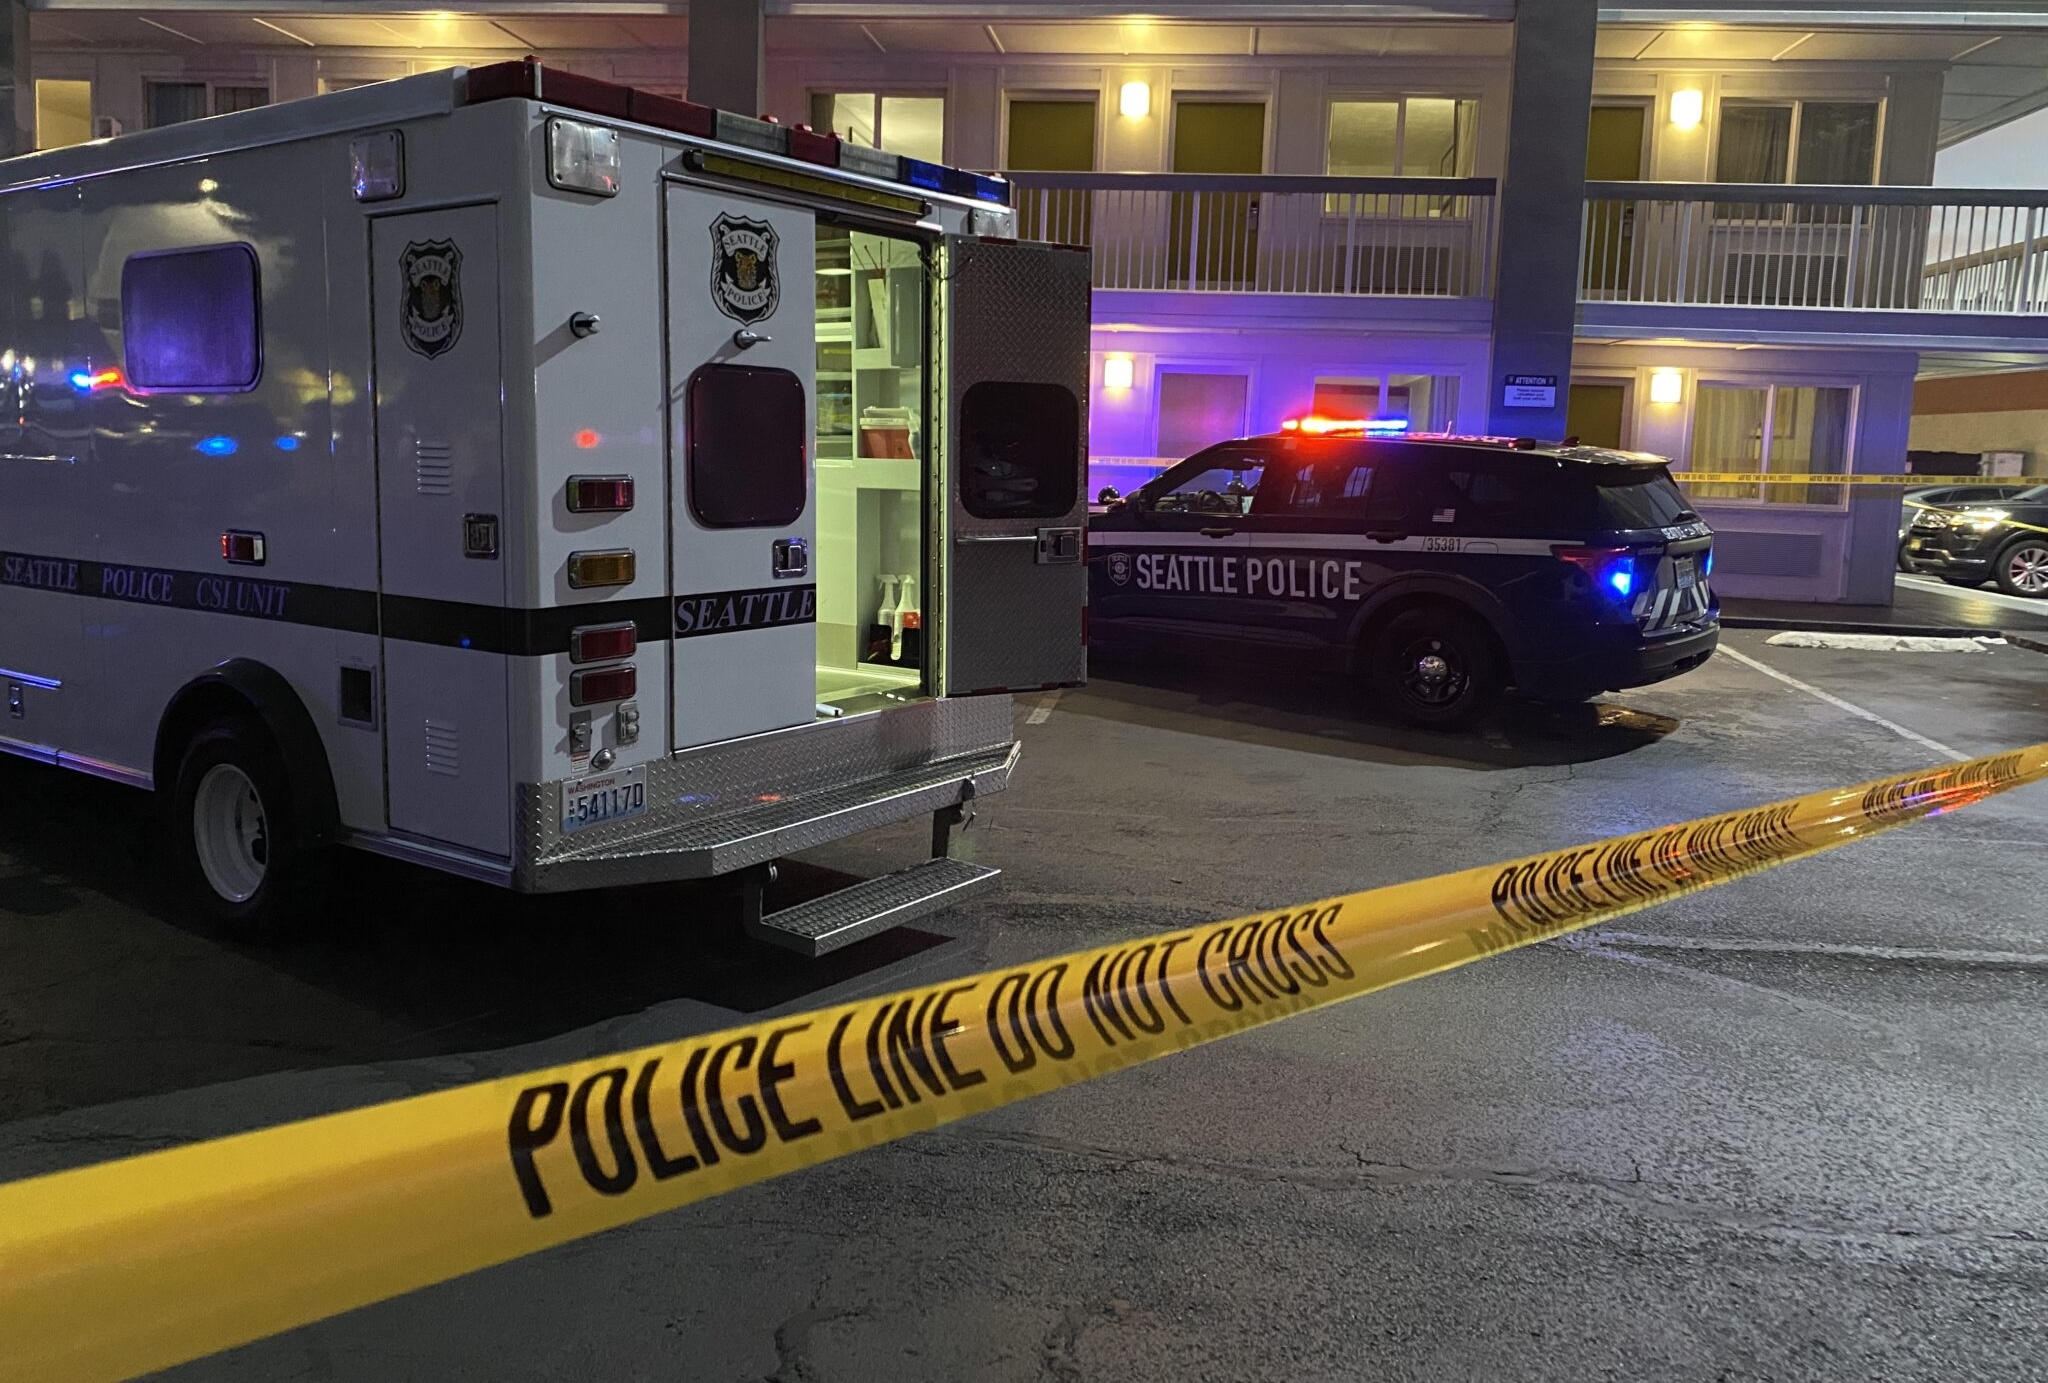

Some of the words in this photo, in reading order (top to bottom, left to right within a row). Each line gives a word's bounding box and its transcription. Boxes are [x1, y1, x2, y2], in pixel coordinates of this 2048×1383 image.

[723, 234, 768, 253] SEATTLE
[727, 289, 765, 306] POLICE
[413, 317, 450, 338] POLICE
[1427, 537, 1461, 552] 35381
[3, 556, 78, 591] SEATTLE
[101, 566, 174, 602] POLICE
[197, 577, 230, 610] CSI
[236, 583, 290, 616] UNIT
[1136, 553, 1238, 594] SEATTLE
[1246, 556, 1362, 600] POLICE
[675, 588, 816, 633] SEATTLE
[567, 778, 616, 795] WASHINGTON
[1491, 847, 1610, 932] POLICE
[1592, 835, 1668, 901] LINE
[508, 1021, 823, 1219] POLICE
[827, 982, 987, 1122] LINE
[986, 963, 1075, 1074] DO
[1083, 935, 1194, 1047] NOT
[1197, 903, 1355, 1012] CROSS
